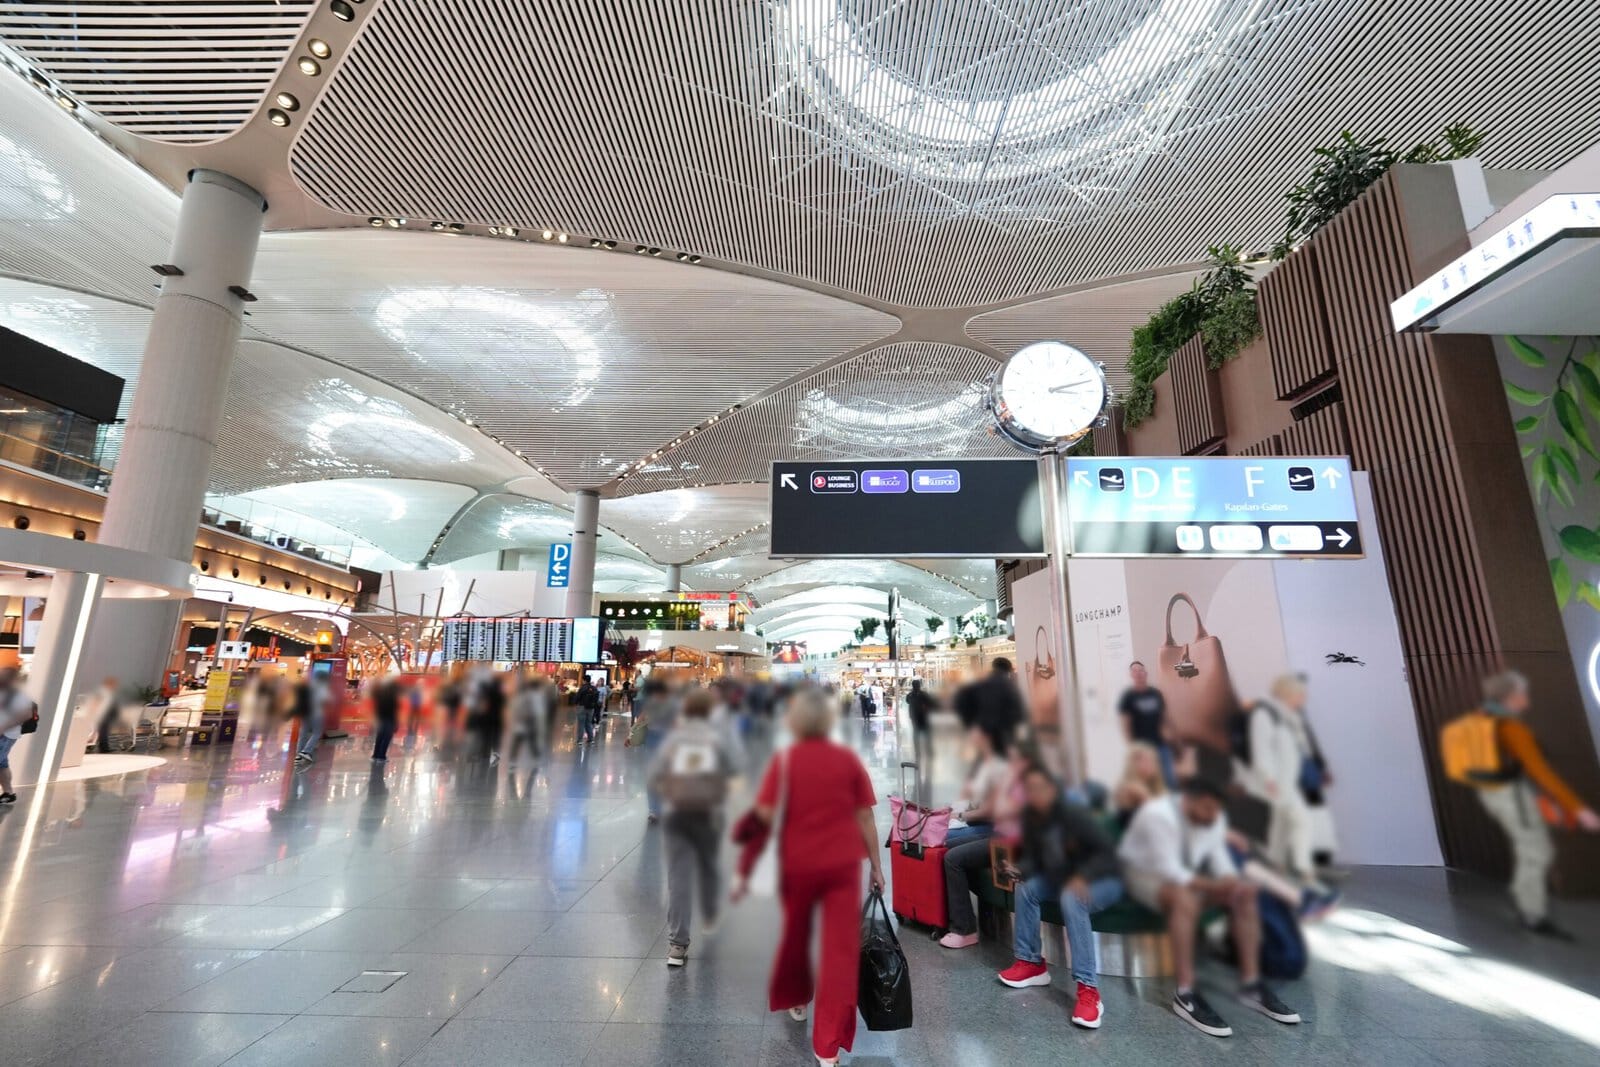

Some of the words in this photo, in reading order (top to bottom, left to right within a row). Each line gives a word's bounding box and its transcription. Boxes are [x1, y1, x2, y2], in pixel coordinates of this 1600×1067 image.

[1131, 466, 1160, 498] D
[1172, 466, 1194, 498] E
[1244, 466, 1264, 498] F
[554, 544, 568, 561] D
[1075, 605, 1121, 623] LONGCHAMP
